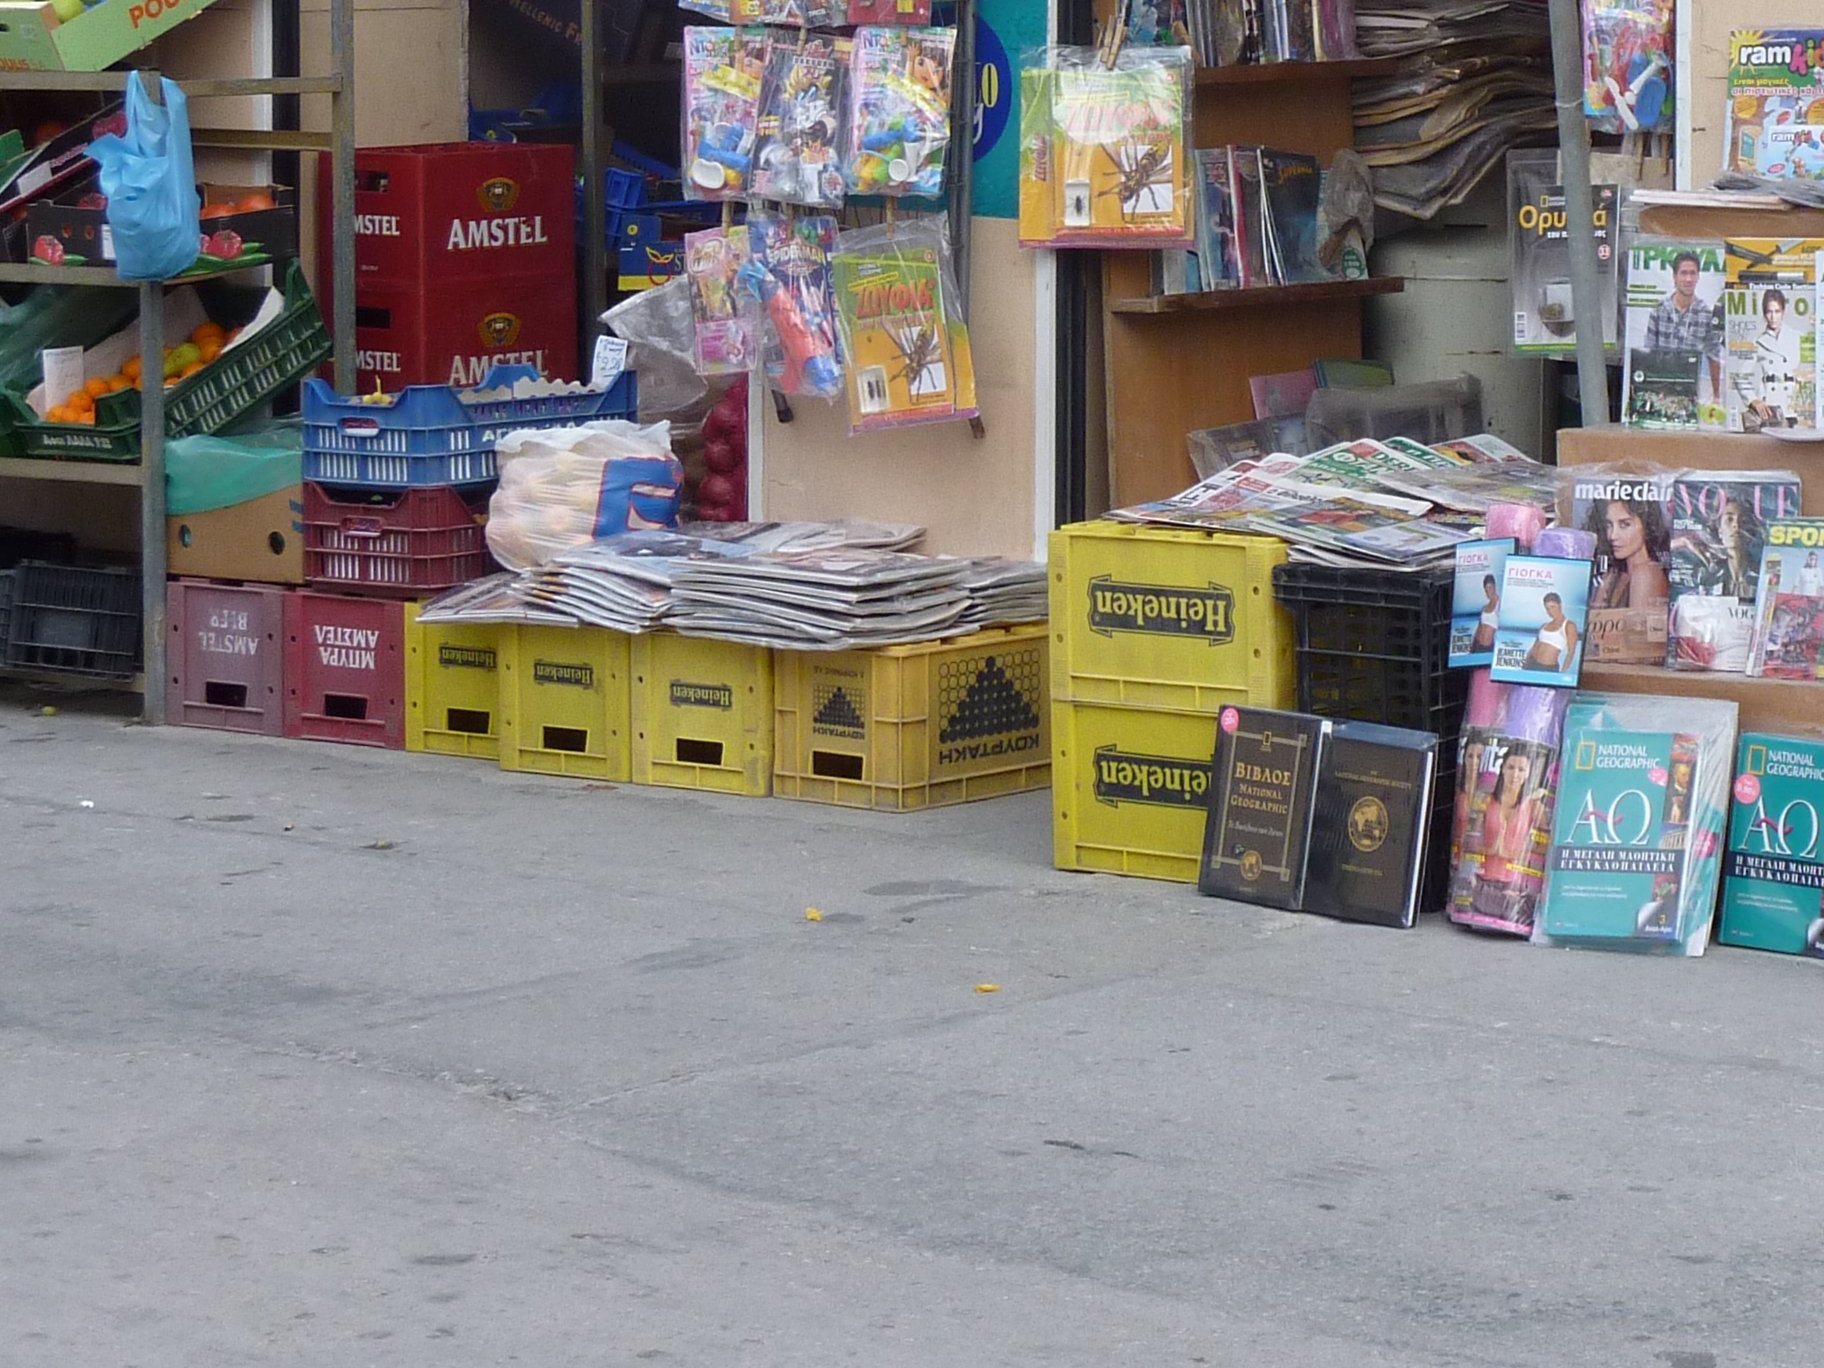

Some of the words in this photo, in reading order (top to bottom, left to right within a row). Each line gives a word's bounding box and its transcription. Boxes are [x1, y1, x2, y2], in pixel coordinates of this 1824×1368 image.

[354, 215, 400, 237] MSTEL
[1519, 202, 1608, 236] Ορυά
[447, 216, 548, 251] AMSTEL
[357, 351, 401, 372] MSTEL
[1575, 484, 1631, 499] marie
[1675, 482, 1799, 518] VOUE
[1458, 554, 1489, 564] ΓΙΟΓΚΑ
[1508, 567, 1552, 579] ΓΙΟΓΚΑ
[1094, 588, 1229, 633] Heineken
[314, 624, 380, 650] ΑΜΣΤΕΛ
[319, 646, 375, 670] ΜΠΥΡΑ
[440, 646, 496, 668] Heineken
[535, 661, 594, 686] Heineken
[673, 685, 730, 707] Heineken
[938, 733, 1041, 765] ΚΟΥΡΤΑΚΗ
[1598, 744, 1647, 757] NATIONAL
[1768, 750, 1816, 767] NATIONAL
[1235, 762, 1292, 786] ΒΙΒΛΟΣ
[1596, 757, 1660, 769] GEOGRAPHIC
[1100, 759, 1213, 796] eineken
[1239, 784, 1283, 800] NATIONAL
[1231, 796, 1288, 814] GEOGRAPHIC
[1564, 789, 1651, 845] ΑΩ
[1736, 794, 1819, 858] ΑΩ
[1560, 860, 1674, 872] ΕΓΚΥΚΛΟΠΑΙΔΕΙΑ
[1562, 849, 1570, 859] Η
[1573, 849, 1614, 860] ΜΕΓΑΛΗ
[1617, 851, 1676, 862] ΜΑΘΗΤΙΚΗ
[1736, 855, 1744, 866] Η
[1746, 857, 1787, 871] ΜΕΓΑΛΗ
[1659, 916, 1666, 924] 3
